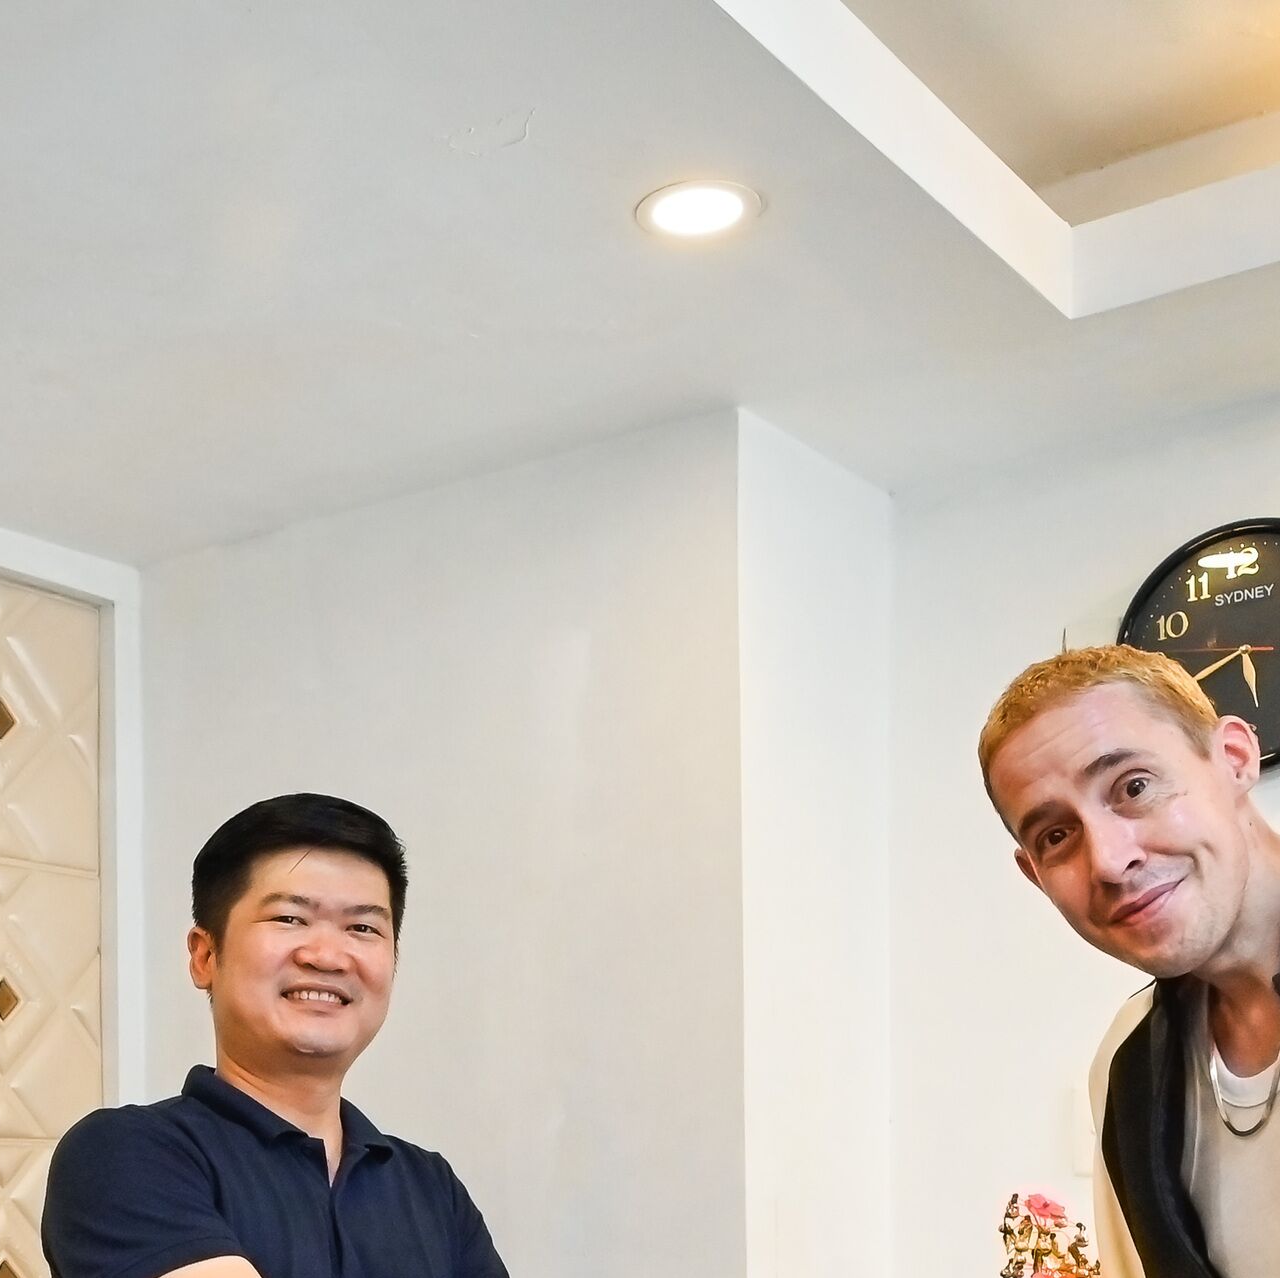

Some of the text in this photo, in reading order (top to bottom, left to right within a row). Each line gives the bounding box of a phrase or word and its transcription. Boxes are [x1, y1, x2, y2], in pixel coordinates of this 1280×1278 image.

[1185, 571, 1212, 602] 11
[1214, 583, 1275, 607] SYDNEY
[1156, 611, 1190, 641] 10
